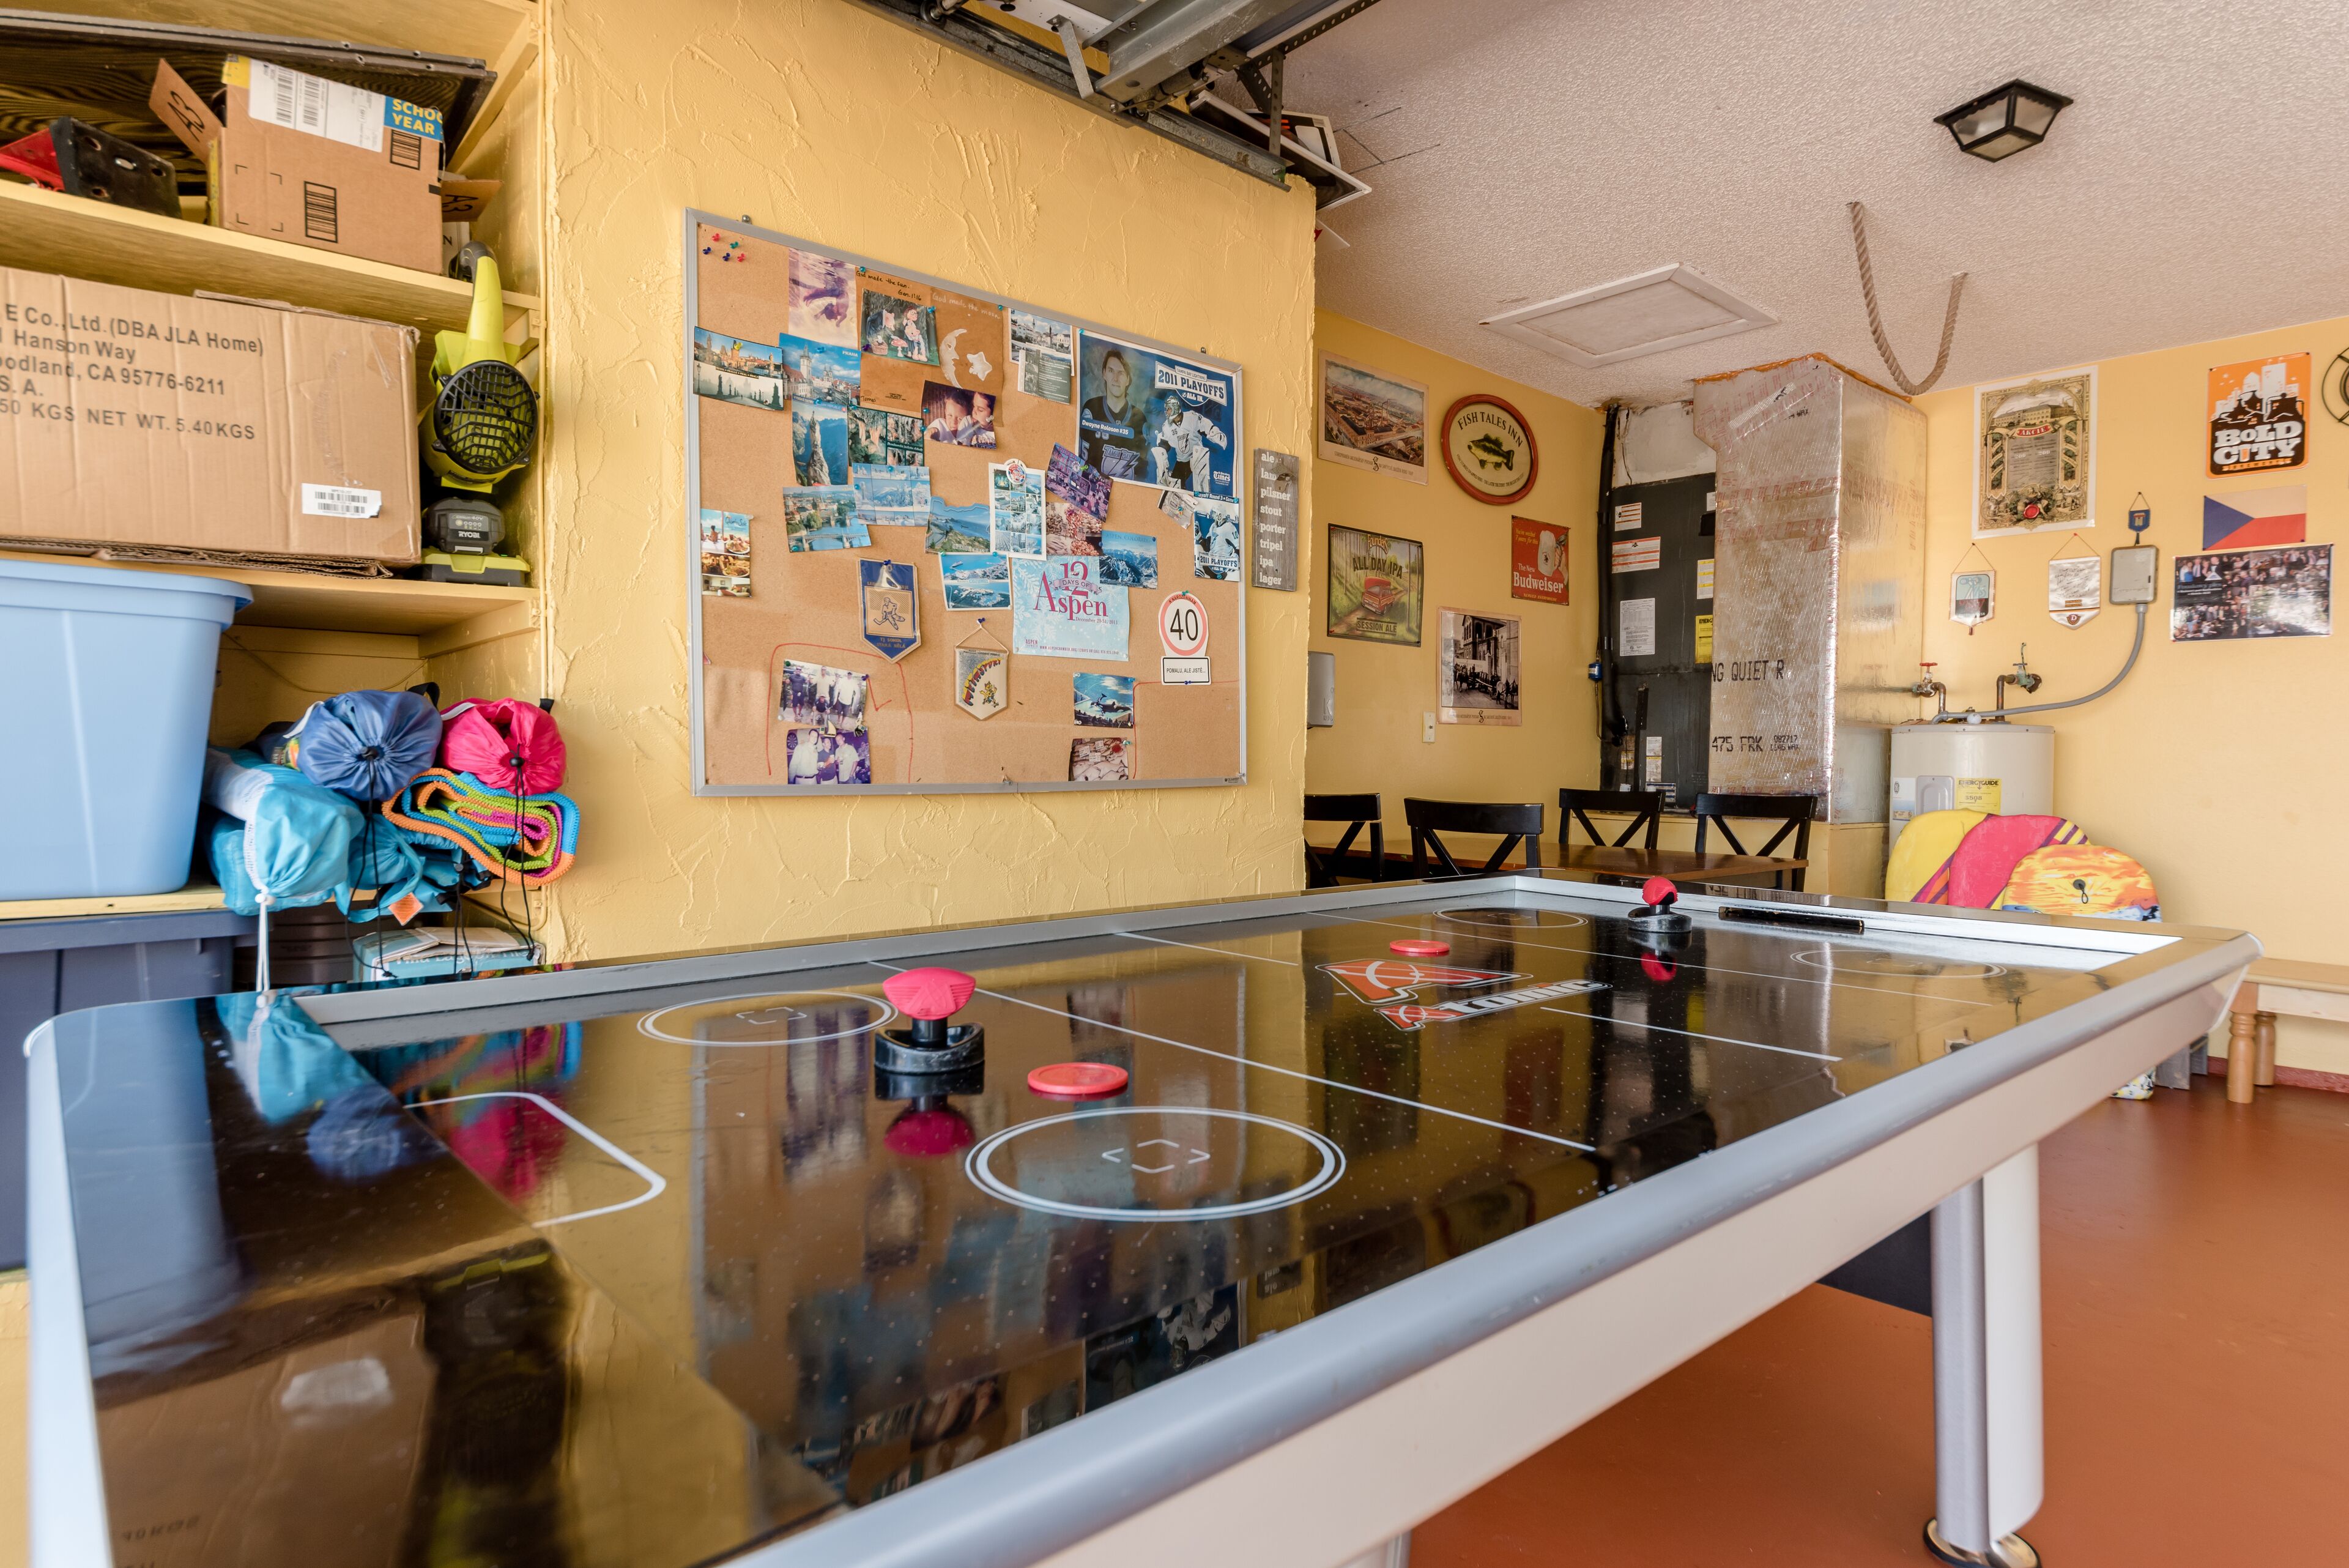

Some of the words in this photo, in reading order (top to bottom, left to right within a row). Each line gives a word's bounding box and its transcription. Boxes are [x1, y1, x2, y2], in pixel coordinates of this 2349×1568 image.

[392, 113, 436, 135] YEAR
[933, 292, 947, 303] God
[949, 298, 967, 308] made
[968, 303, 979, 311] the
[13, 329, 90, 355] Hanson
[95, 340, 136, 365] Way
[165, 326, 201, 346] JLA
[206, 332, 264, 357] Home)
[87, 363, 117, 382] CA
[122, 368, 225, 395] 95776-6211
[1158, 370, 1178, 385] 2011
[1181, 377, 1224, 399] PLAYOFFS
[32, 402, 75, 422] KGS
[87, 408, 127, 426] NET
[136, 414, 171, 431] WT.
[1082, 420, 1100, 429] Dwayne
[1458, 412, 1478, 430] FISH
[1480, 412, 1506, 431] TALES
[1508, 425, 1523, 447] INN
[2020, 426, 2046, 436] AKCIE
[1261, 452, 1274, 463] ale
[1214, 473, 1230, 481] Times
[1260, 487, 1291, 500] pilsner
[1260, 505, 1282, 516] stout
[1260, 522, 1286, 535] porter
[1260, 538, 1283, 551] tripel
[1367, 534, 1389, 554] Founders
[1211, 557, 1238, 567] PLAYOFFS
[1260, 555, 1274, 567] ipa
[1353, 557, 1368, 571] ALL
[1371, 558, 1386, 573] DAY
[1389, 562, 1403, 579] IPA
[1060, 561, 1088, 599] 12
[1260, 572, 1282, 585] lager
[1513, 571, 1564, 593] Budweiser
[1033, 571, 1108, 621] Aspen
[1170, 609, 1198, 641] 40
[1357, 620, 1383, 631] SESSION
[1385, 623, 1397, 633] ALE
[1731, 660, 1769, 682] QUIET
[1776, 660, 1784, 680] R
[1712, 737, 1734, 752] 475
[1740, 737, 1763, 751] FRK
